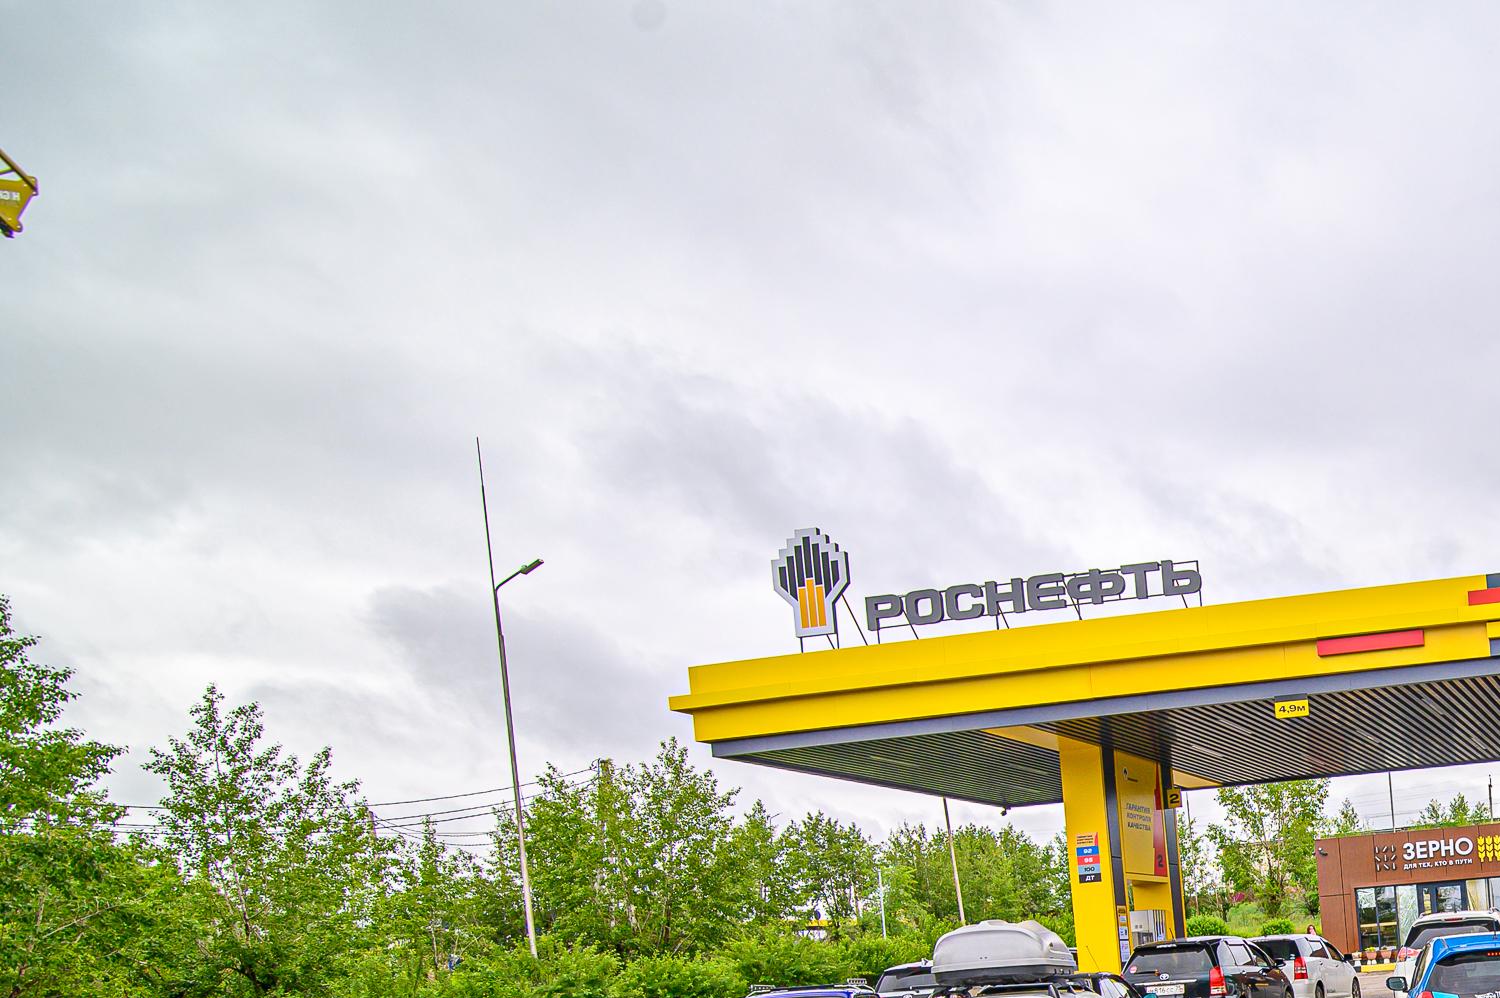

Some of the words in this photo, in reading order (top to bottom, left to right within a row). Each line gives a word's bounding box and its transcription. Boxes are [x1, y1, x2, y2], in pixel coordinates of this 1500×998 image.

[865, 560, 1202, 631] РОСНЕФТЬ
[1169, 793, 1180, 804] 2
[1402, 837, 1474, 861] ЗЕРНО
[1157, 854, 1164, 868] 2
